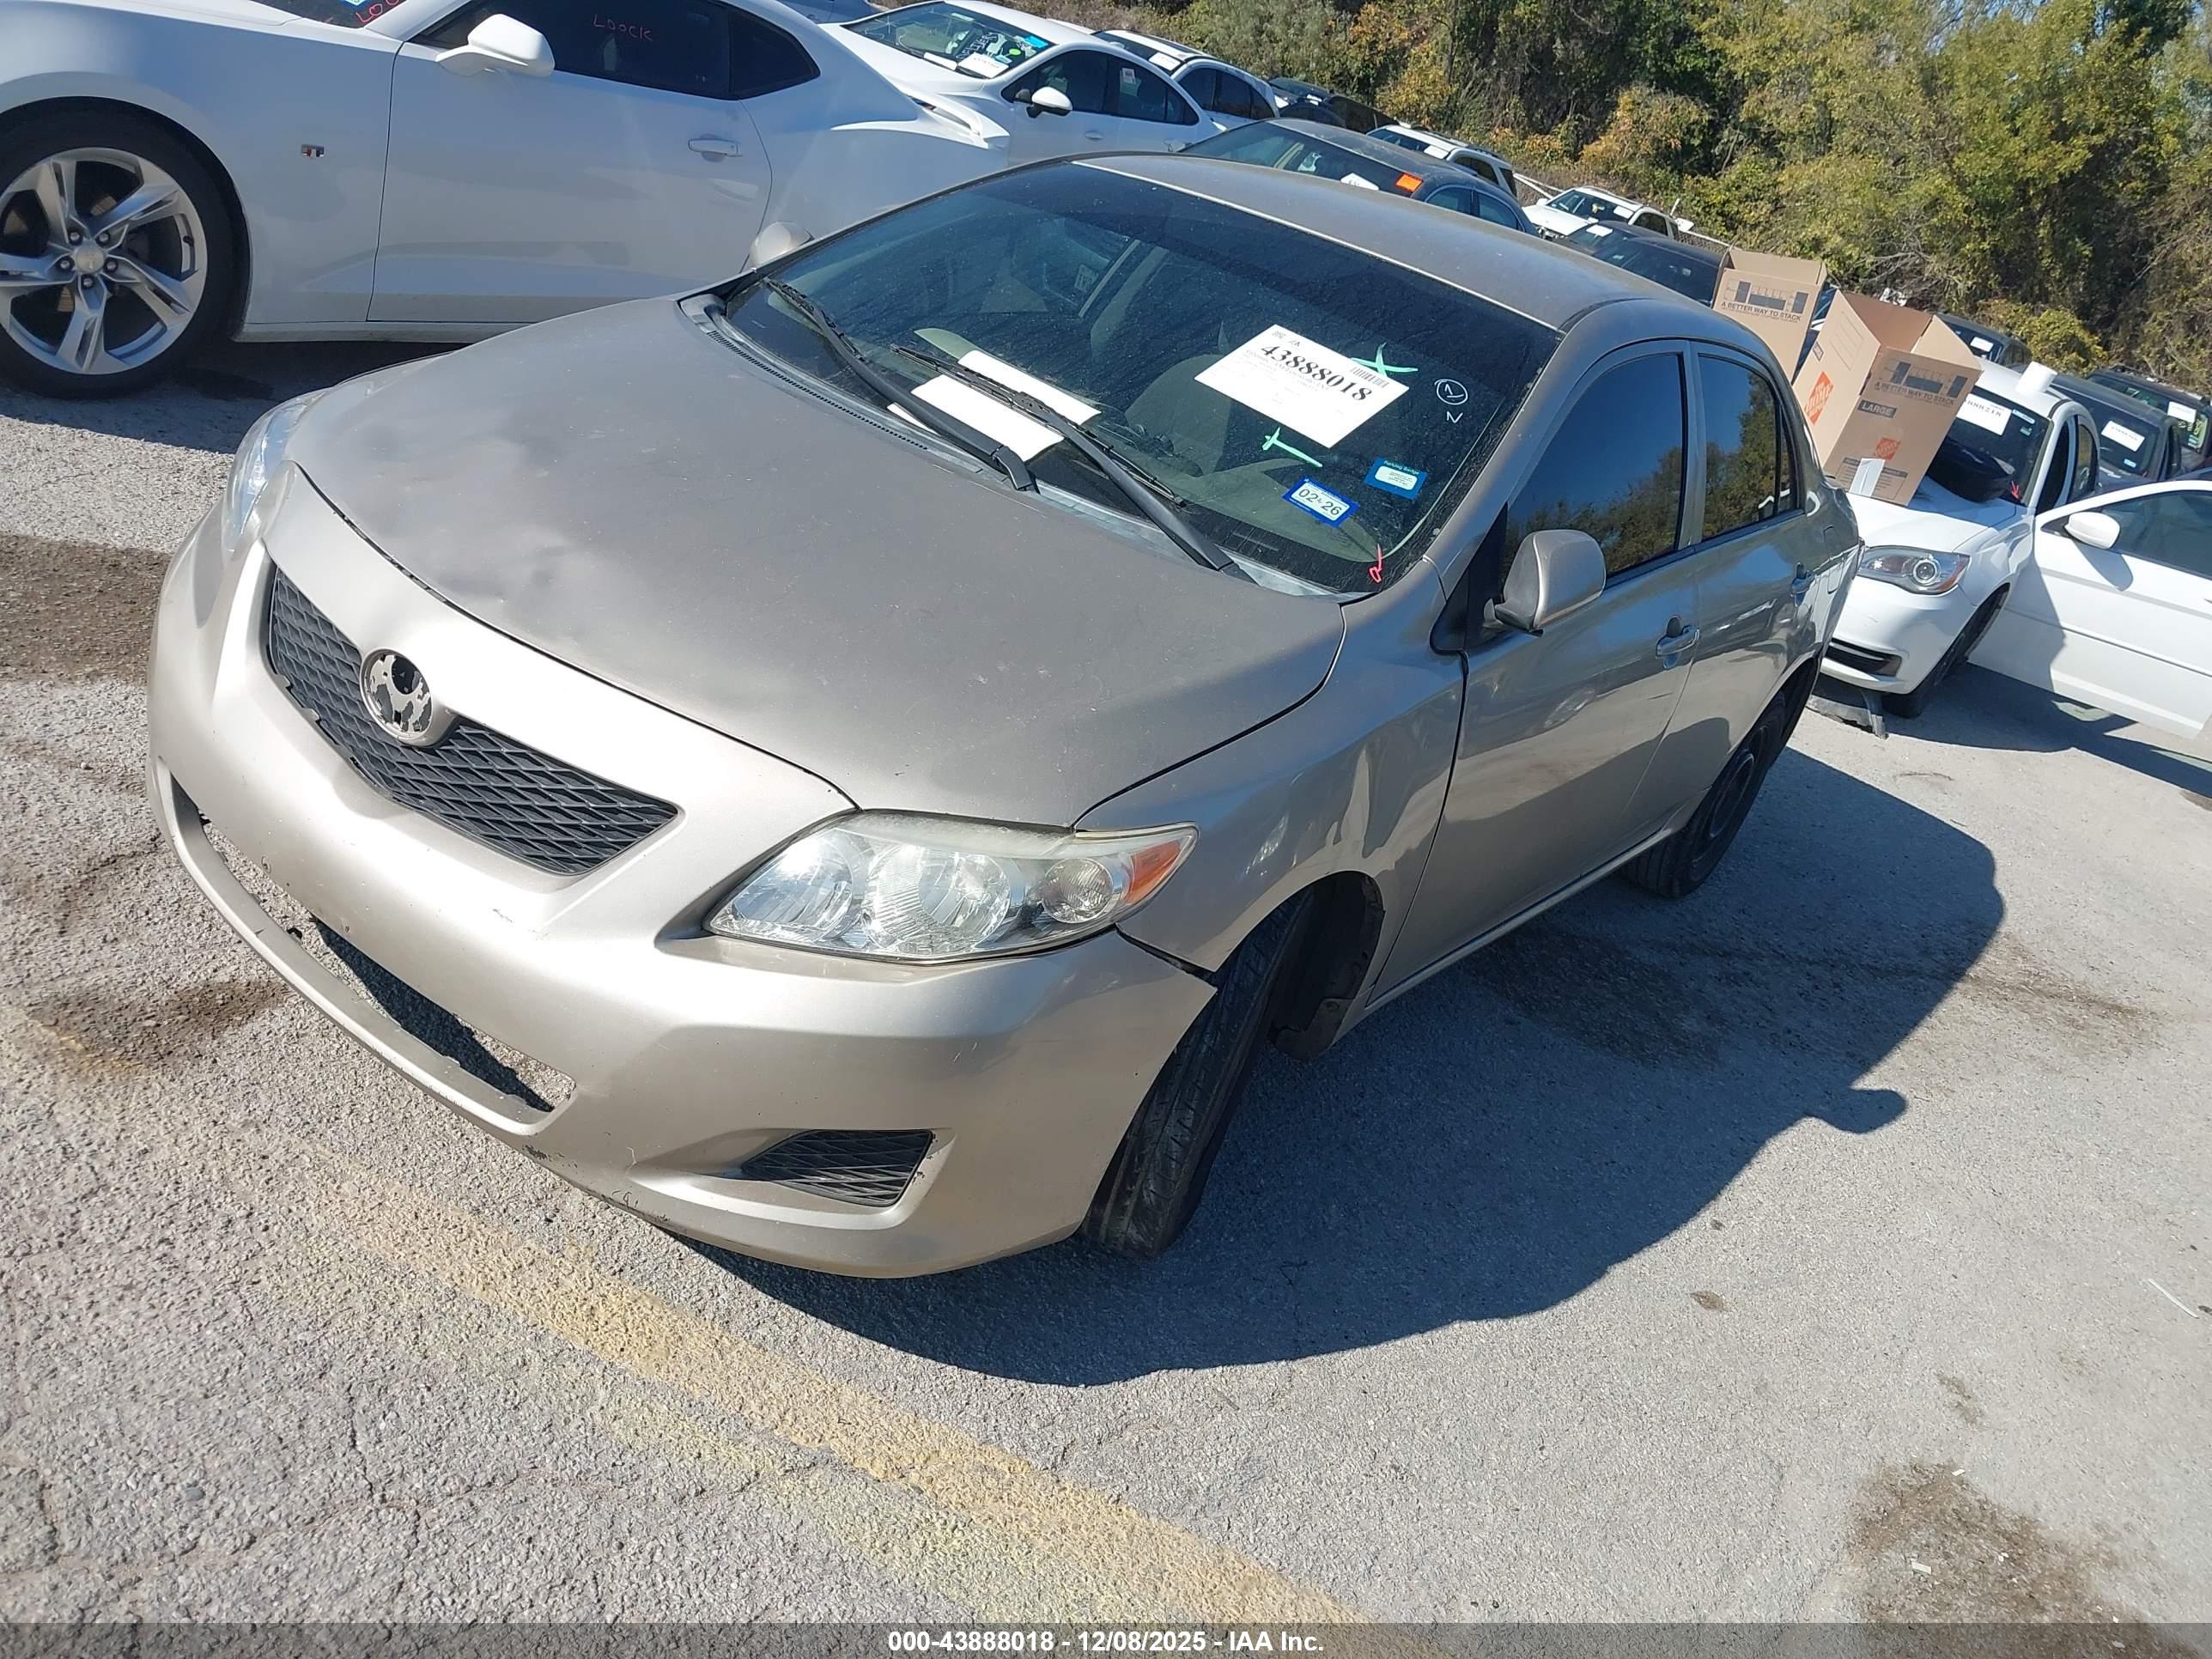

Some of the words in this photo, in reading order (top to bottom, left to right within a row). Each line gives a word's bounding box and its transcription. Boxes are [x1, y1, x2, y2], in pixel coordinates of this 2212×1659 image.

[1727, 302, 1753, 313] BETTER
[1753, 307, 1769, 315] WAY
[1770, 308, 1779, 317] TO
[1779, 310, 1802, 322] STACK
[1261, 345, 1373, 401] 43888018
[1861, 401, 1893, 416] LARGE
[1298, 489, 1319, 503] 02
[1321, 501, 1343, 516] 26
